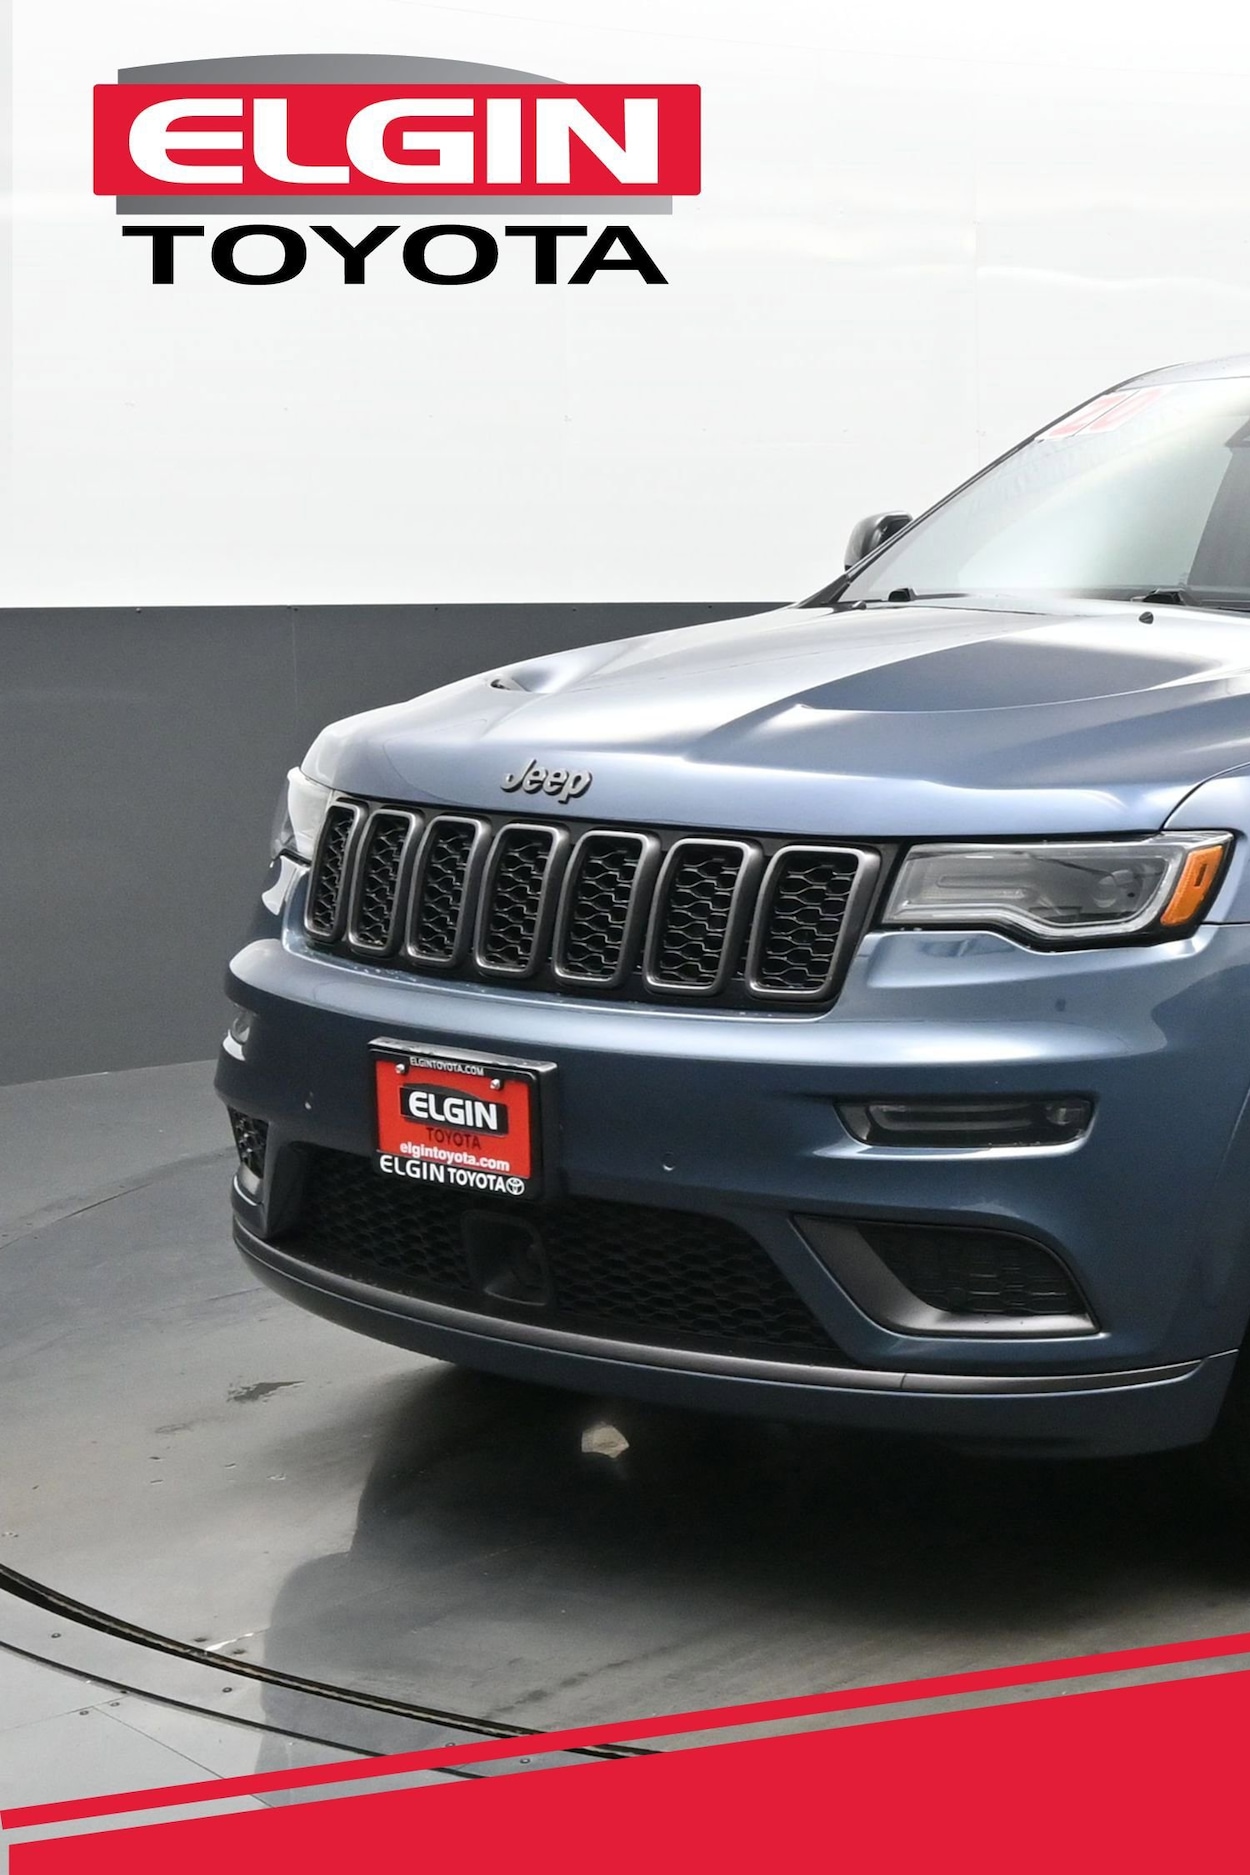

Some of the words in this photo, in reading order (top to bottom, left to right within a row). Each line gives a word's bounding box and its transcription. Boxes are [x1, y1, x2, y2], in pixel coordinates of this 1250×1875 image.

[500, 758, 593, 805] Jeep
[409, 1056, 485, 1077] ELGINTOYOTA.COM
[408, 1091, 498, 1130] ELGIN
[426, 1127, 481, 1150] TOYOTA
[400, 1142, 510, 1171] elgintoyota.com
[380, 1155, 445, 1183] ELGIN
[447, 1167, 507, 1193] TOYOTA
